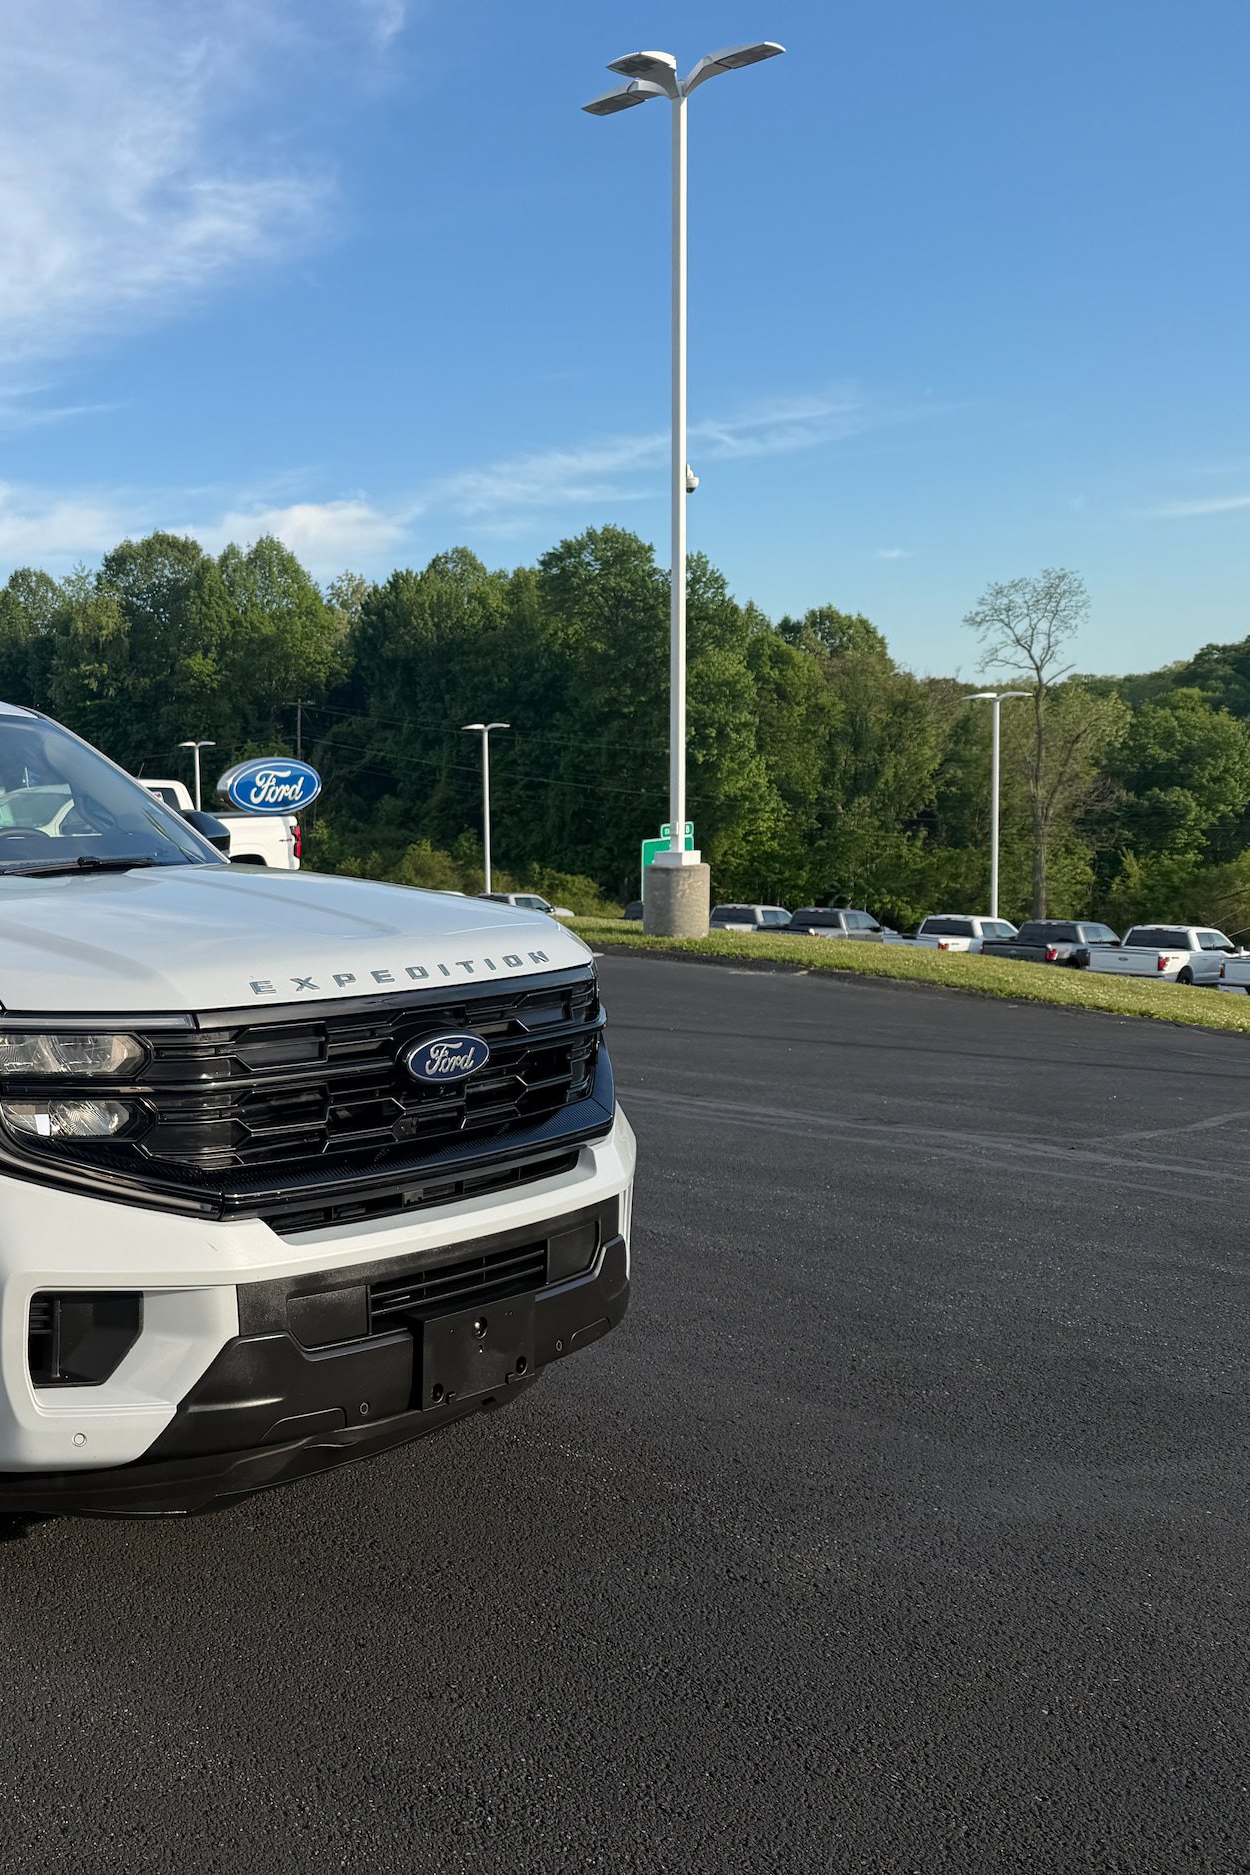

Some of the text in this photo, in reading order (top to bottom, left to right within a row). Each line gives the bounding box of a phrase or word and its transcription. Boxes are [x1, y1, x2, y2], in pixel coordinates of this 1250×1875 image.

[250, 770, 304, 804] Ford
[248, 950, 551, 995] EXPEDITION
[425, 1042, 475, 1075] Ford
